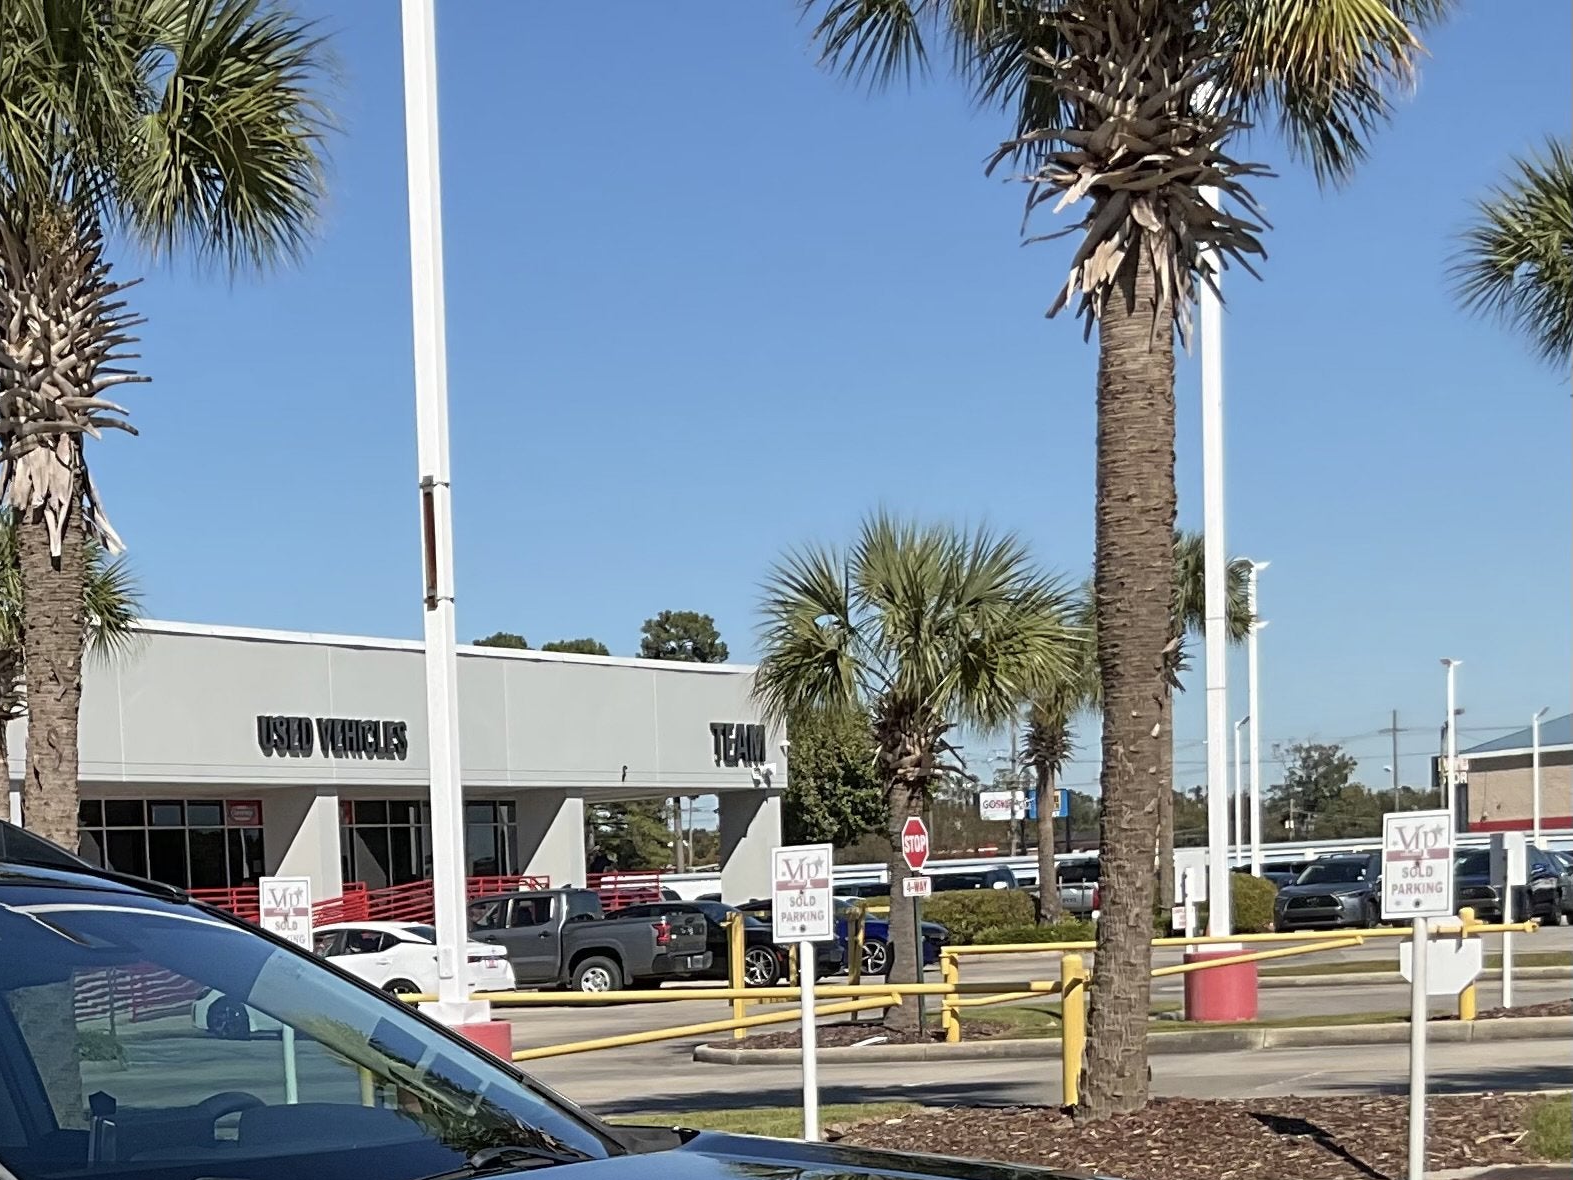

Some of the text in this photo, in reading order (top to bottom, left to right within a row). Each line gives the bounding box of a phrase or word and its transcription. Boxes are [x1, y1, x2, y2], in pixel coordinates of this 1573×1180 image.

[257, 715, 408, 760] USED VEHICLES
[710, 723, 766, 767] TEAM
[904, 834, 926, 853] STOP
[1402, 865, 1434, 879] SOLD
[906, 881, 928, 893] 4-WAY
[1391, 881, 1444, 896] PARKING
[789, 895, 816, 908] SOLD
[780, 910, 825, 923] PARKING
[274, 920, 298, 931] SOLD
